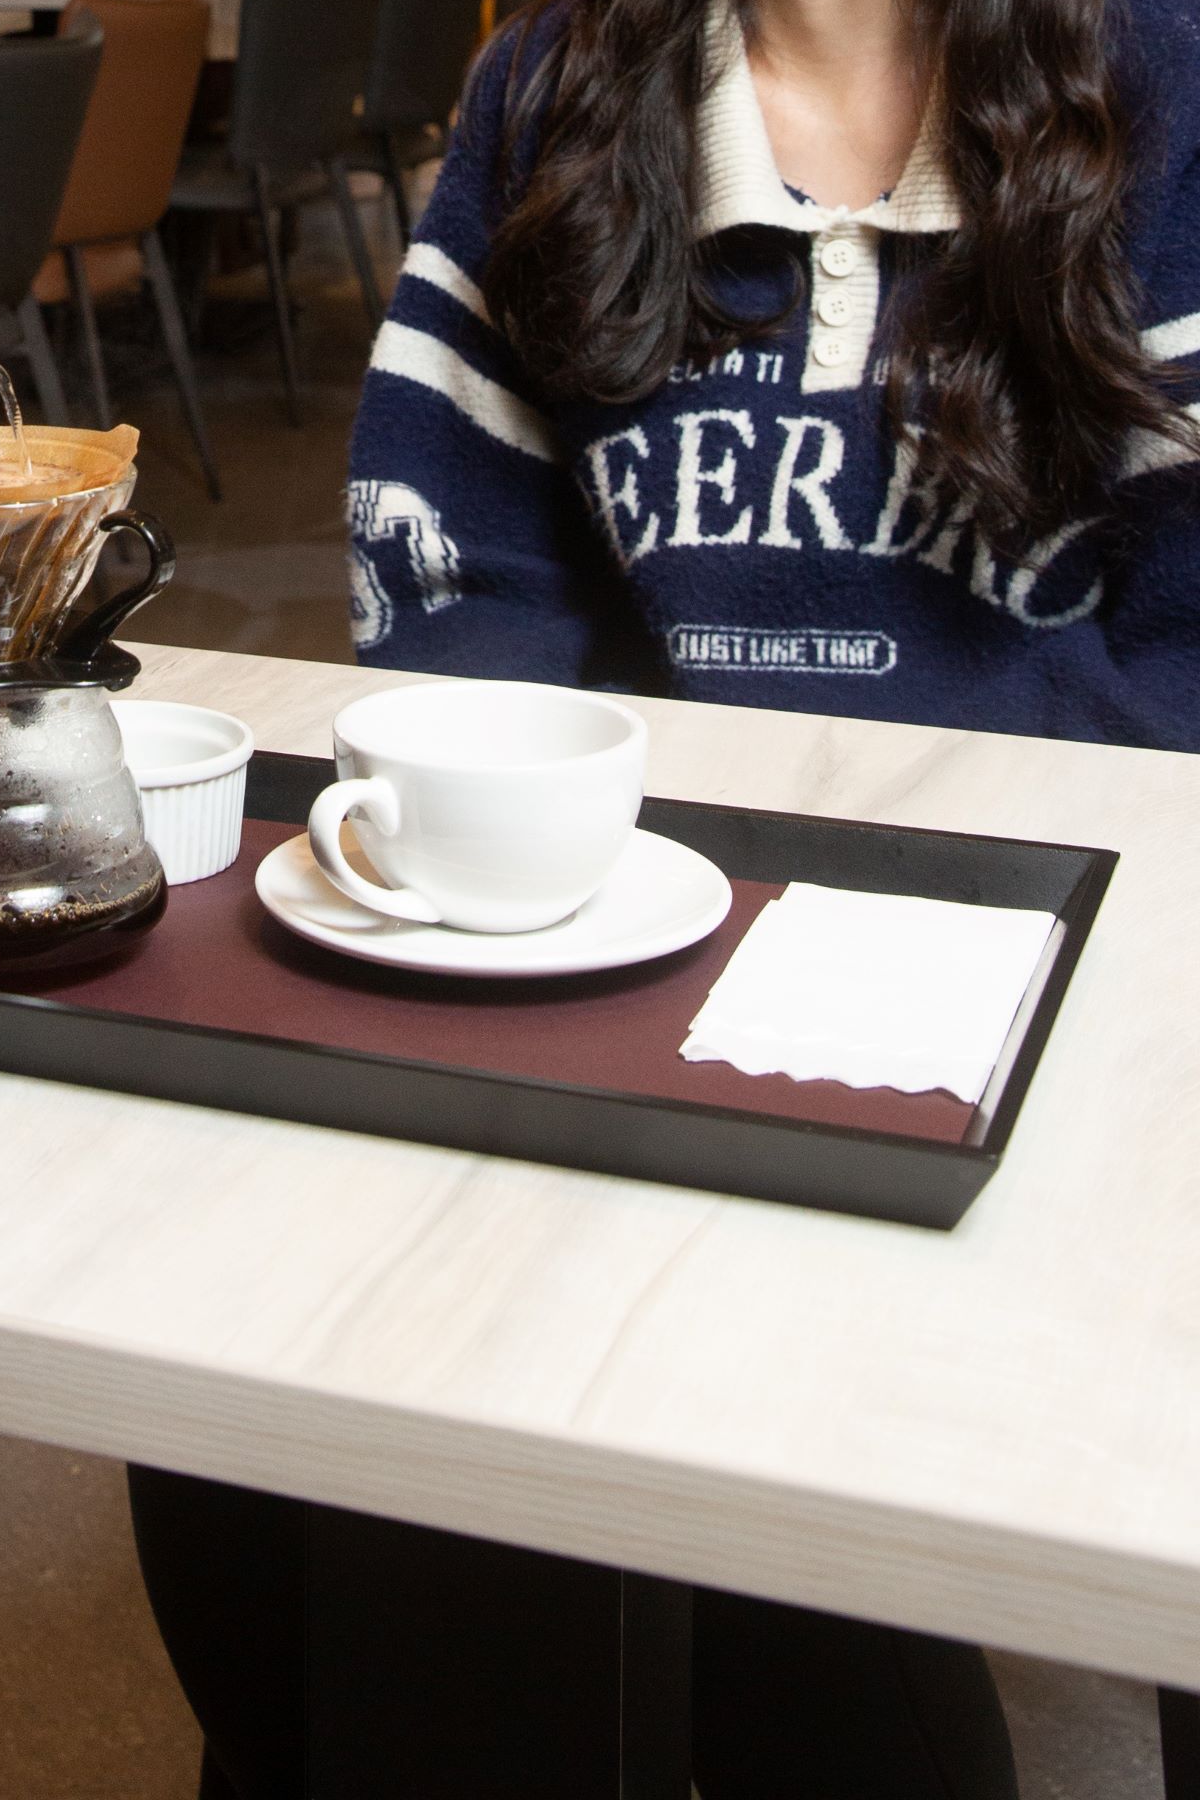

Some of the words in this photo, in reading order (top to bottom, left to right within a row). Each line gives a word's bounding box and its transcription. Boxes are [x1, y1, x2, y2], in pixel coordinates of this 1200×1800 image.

[675, 632, 745, 663] JUST
[750, 636, 807, 665] LIKE
[811, 637, 879, 667] THAT
